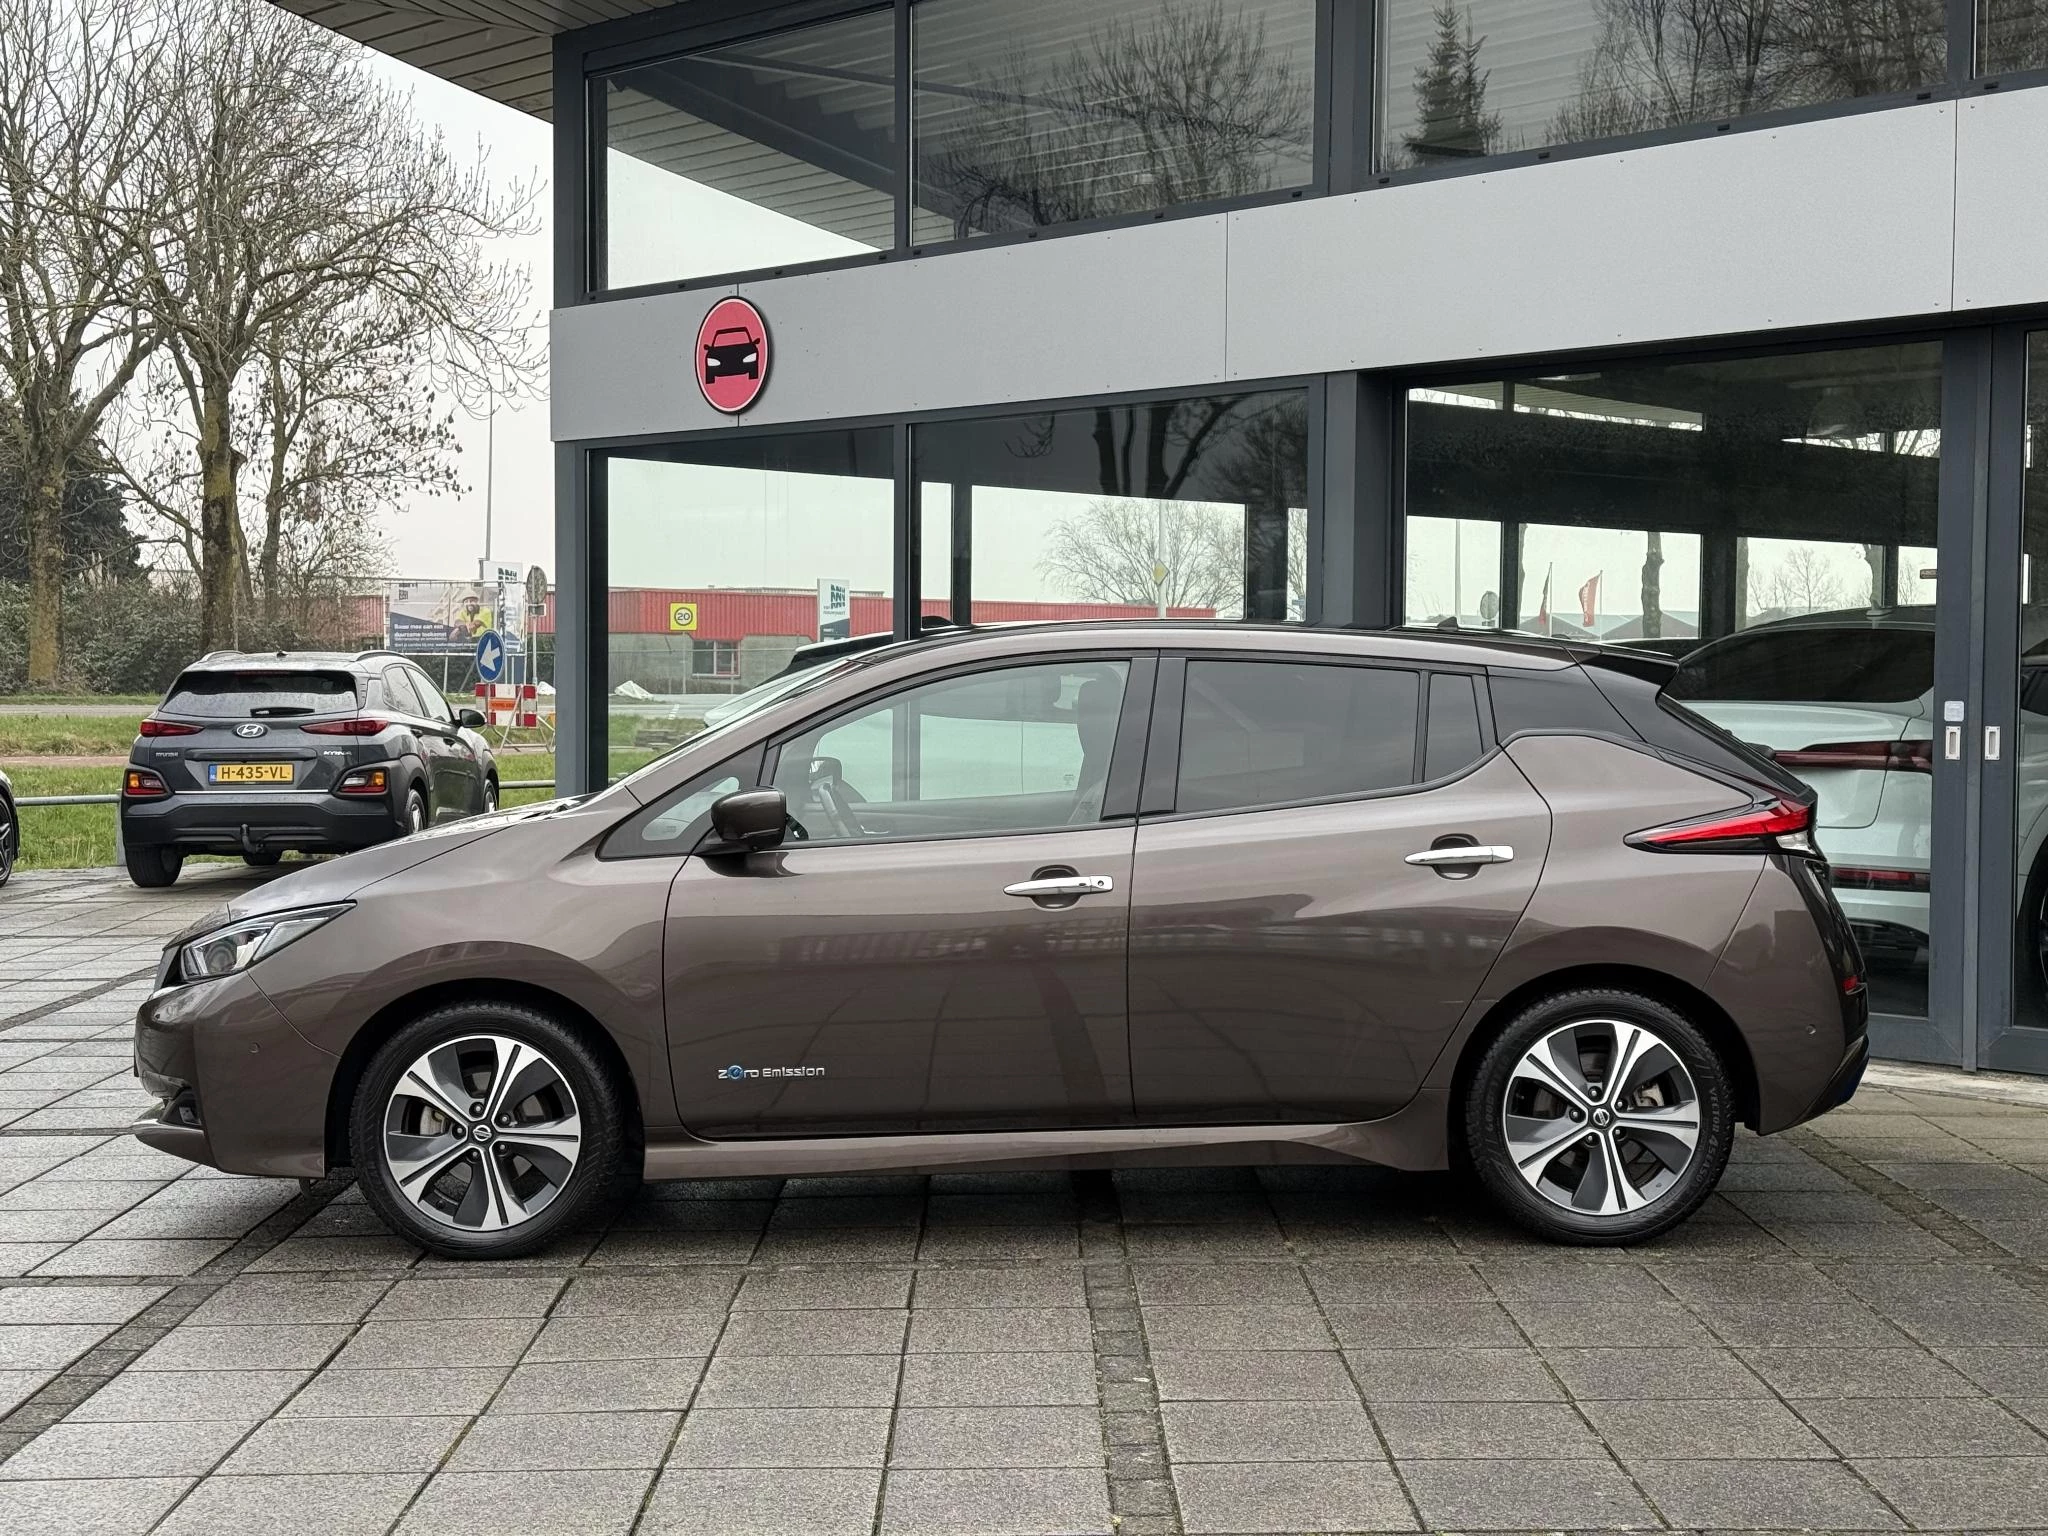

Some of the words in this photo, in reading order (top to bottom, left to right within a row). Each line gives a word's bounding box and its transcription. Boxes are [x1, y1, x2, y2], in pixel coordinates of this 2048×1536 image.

[677, 612, 691, 621] 20
[221, 766, 288, 780] H-435-VL
[762, 1066, 825, 1078] Emission
[1709, 1087, 1721, 1133] VECTOR
